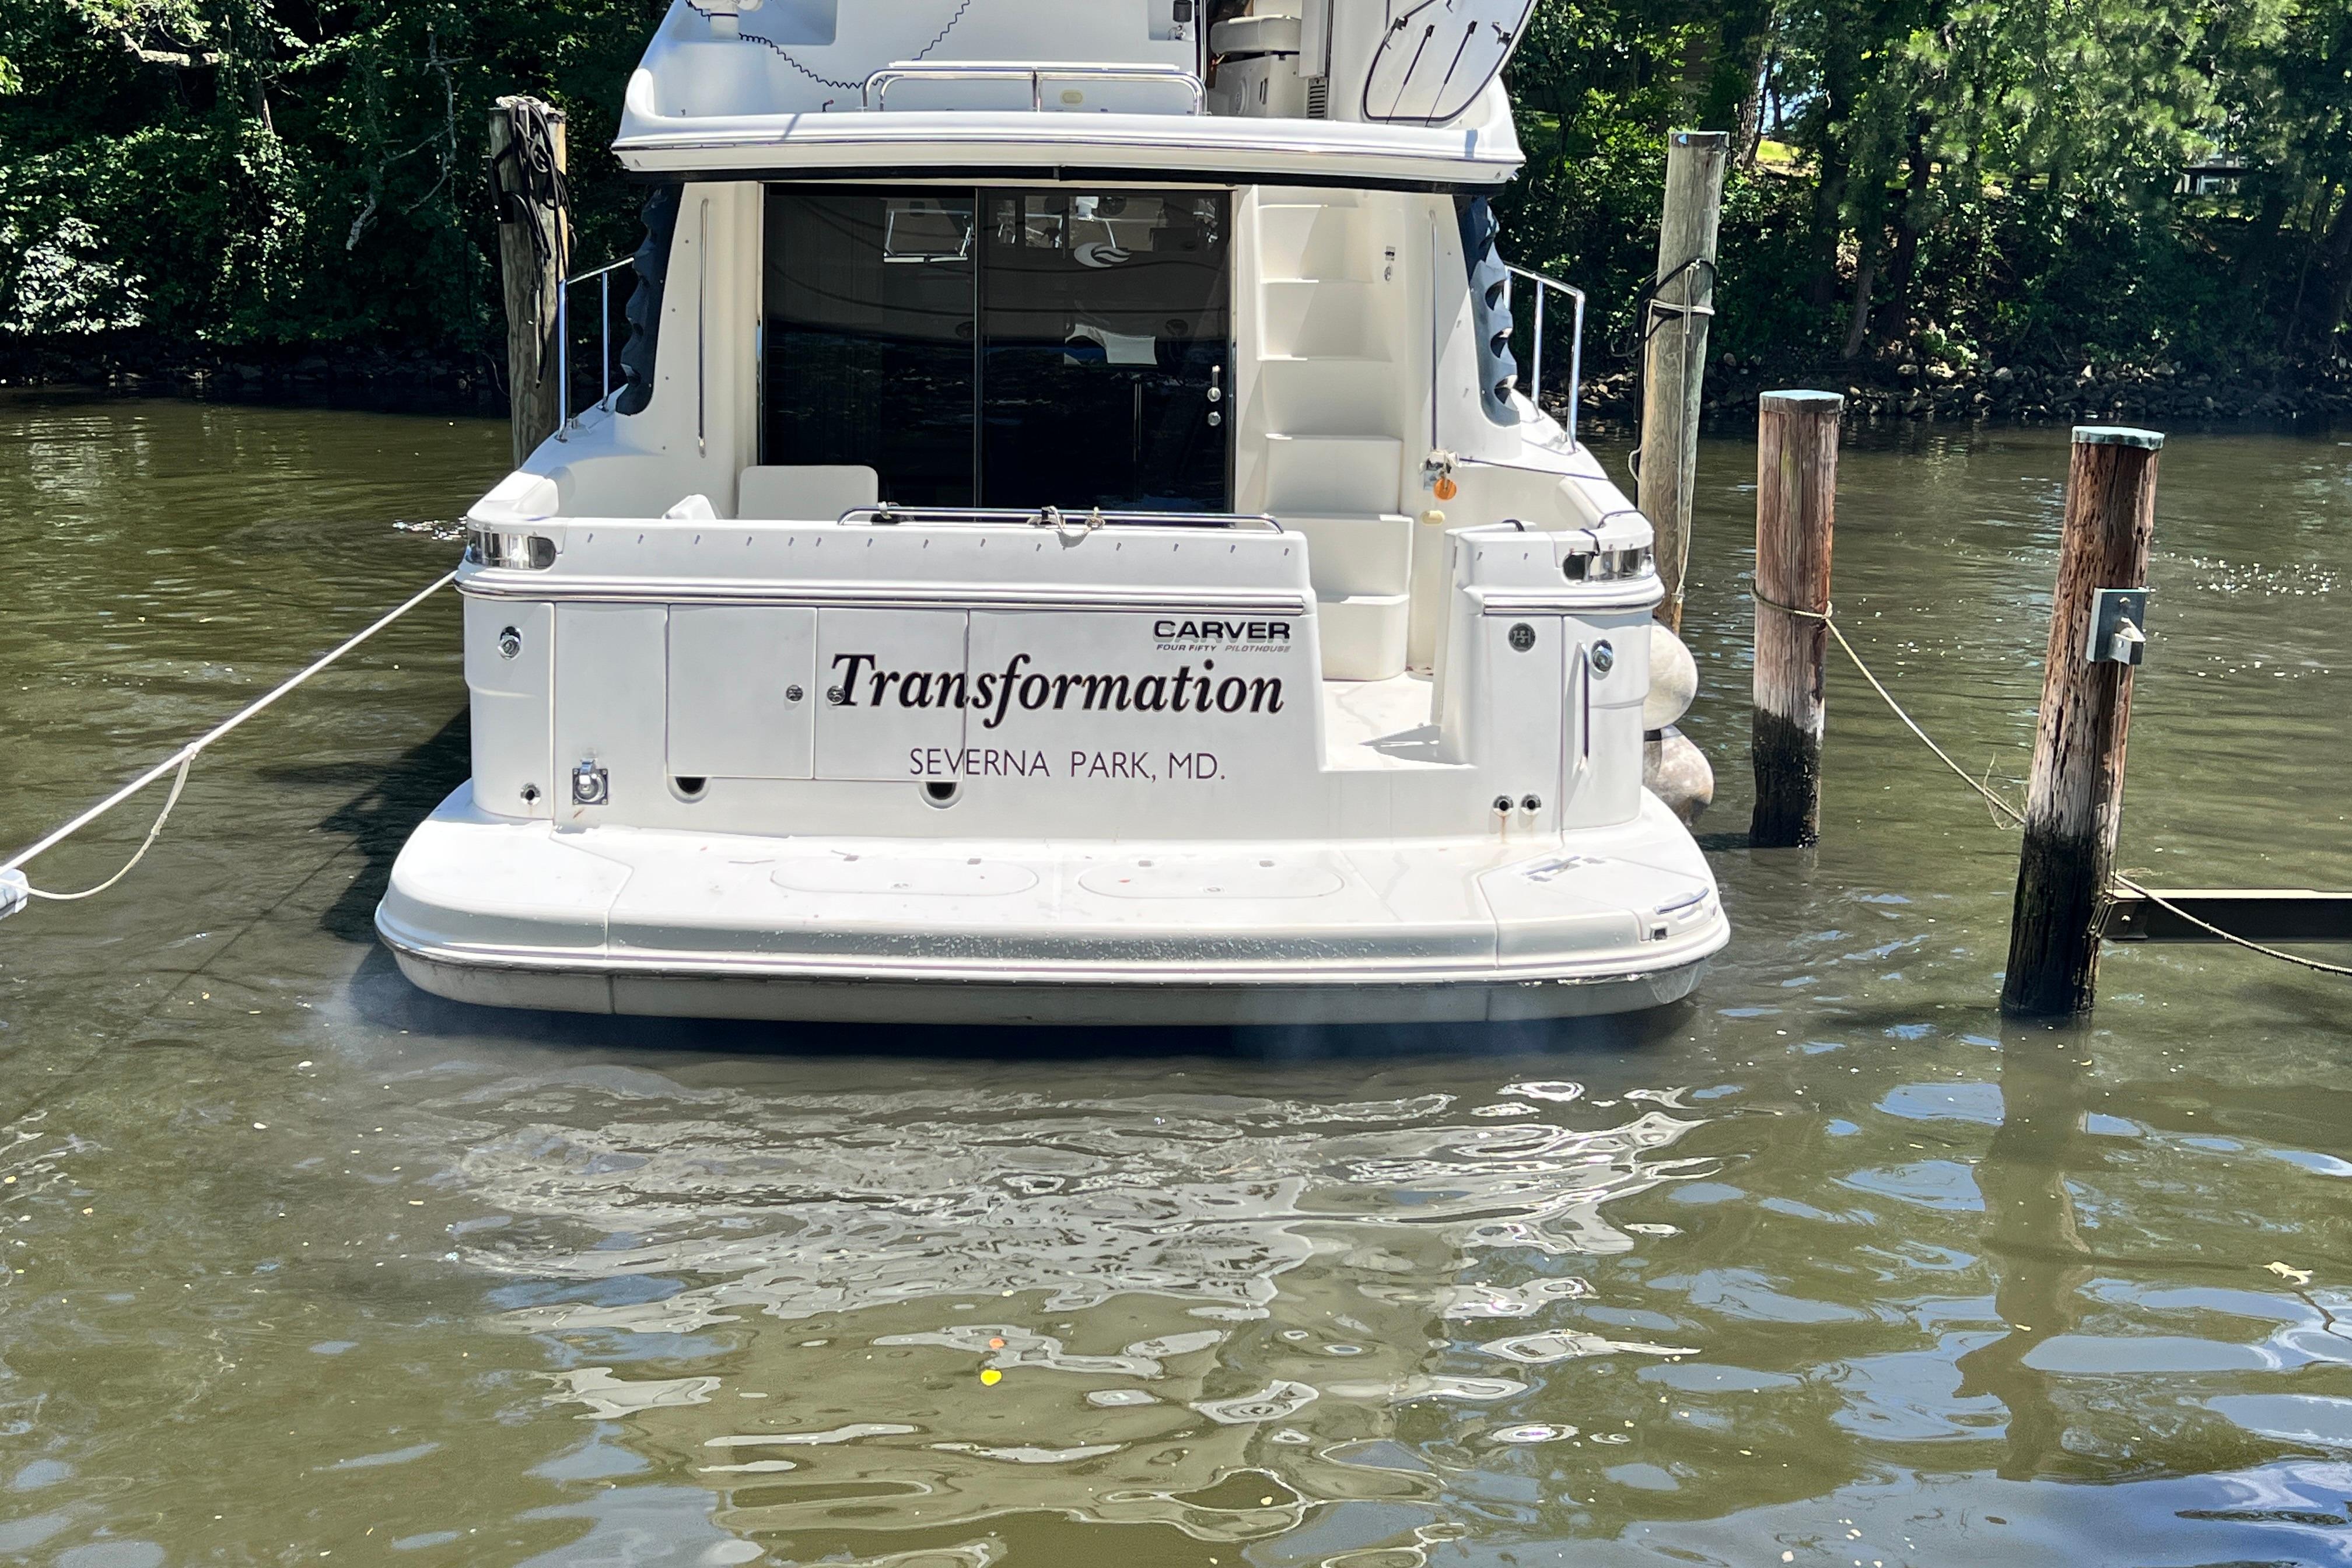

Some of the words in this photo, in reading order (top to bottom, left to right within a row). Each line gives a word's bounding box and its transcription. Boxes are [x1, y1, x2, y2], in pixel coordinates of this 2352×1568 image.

[1154, 620, 1290, 641] CARVER
[1224, 645, 1292, 653] PILOTHOUSE
[831, 653, 1284, 729] Transformation
[910, 748, 1051, 778] SEVERNA
[1070, 750, 1156, 783] PARK,
[1168, 752, 1226, 780] MD.
